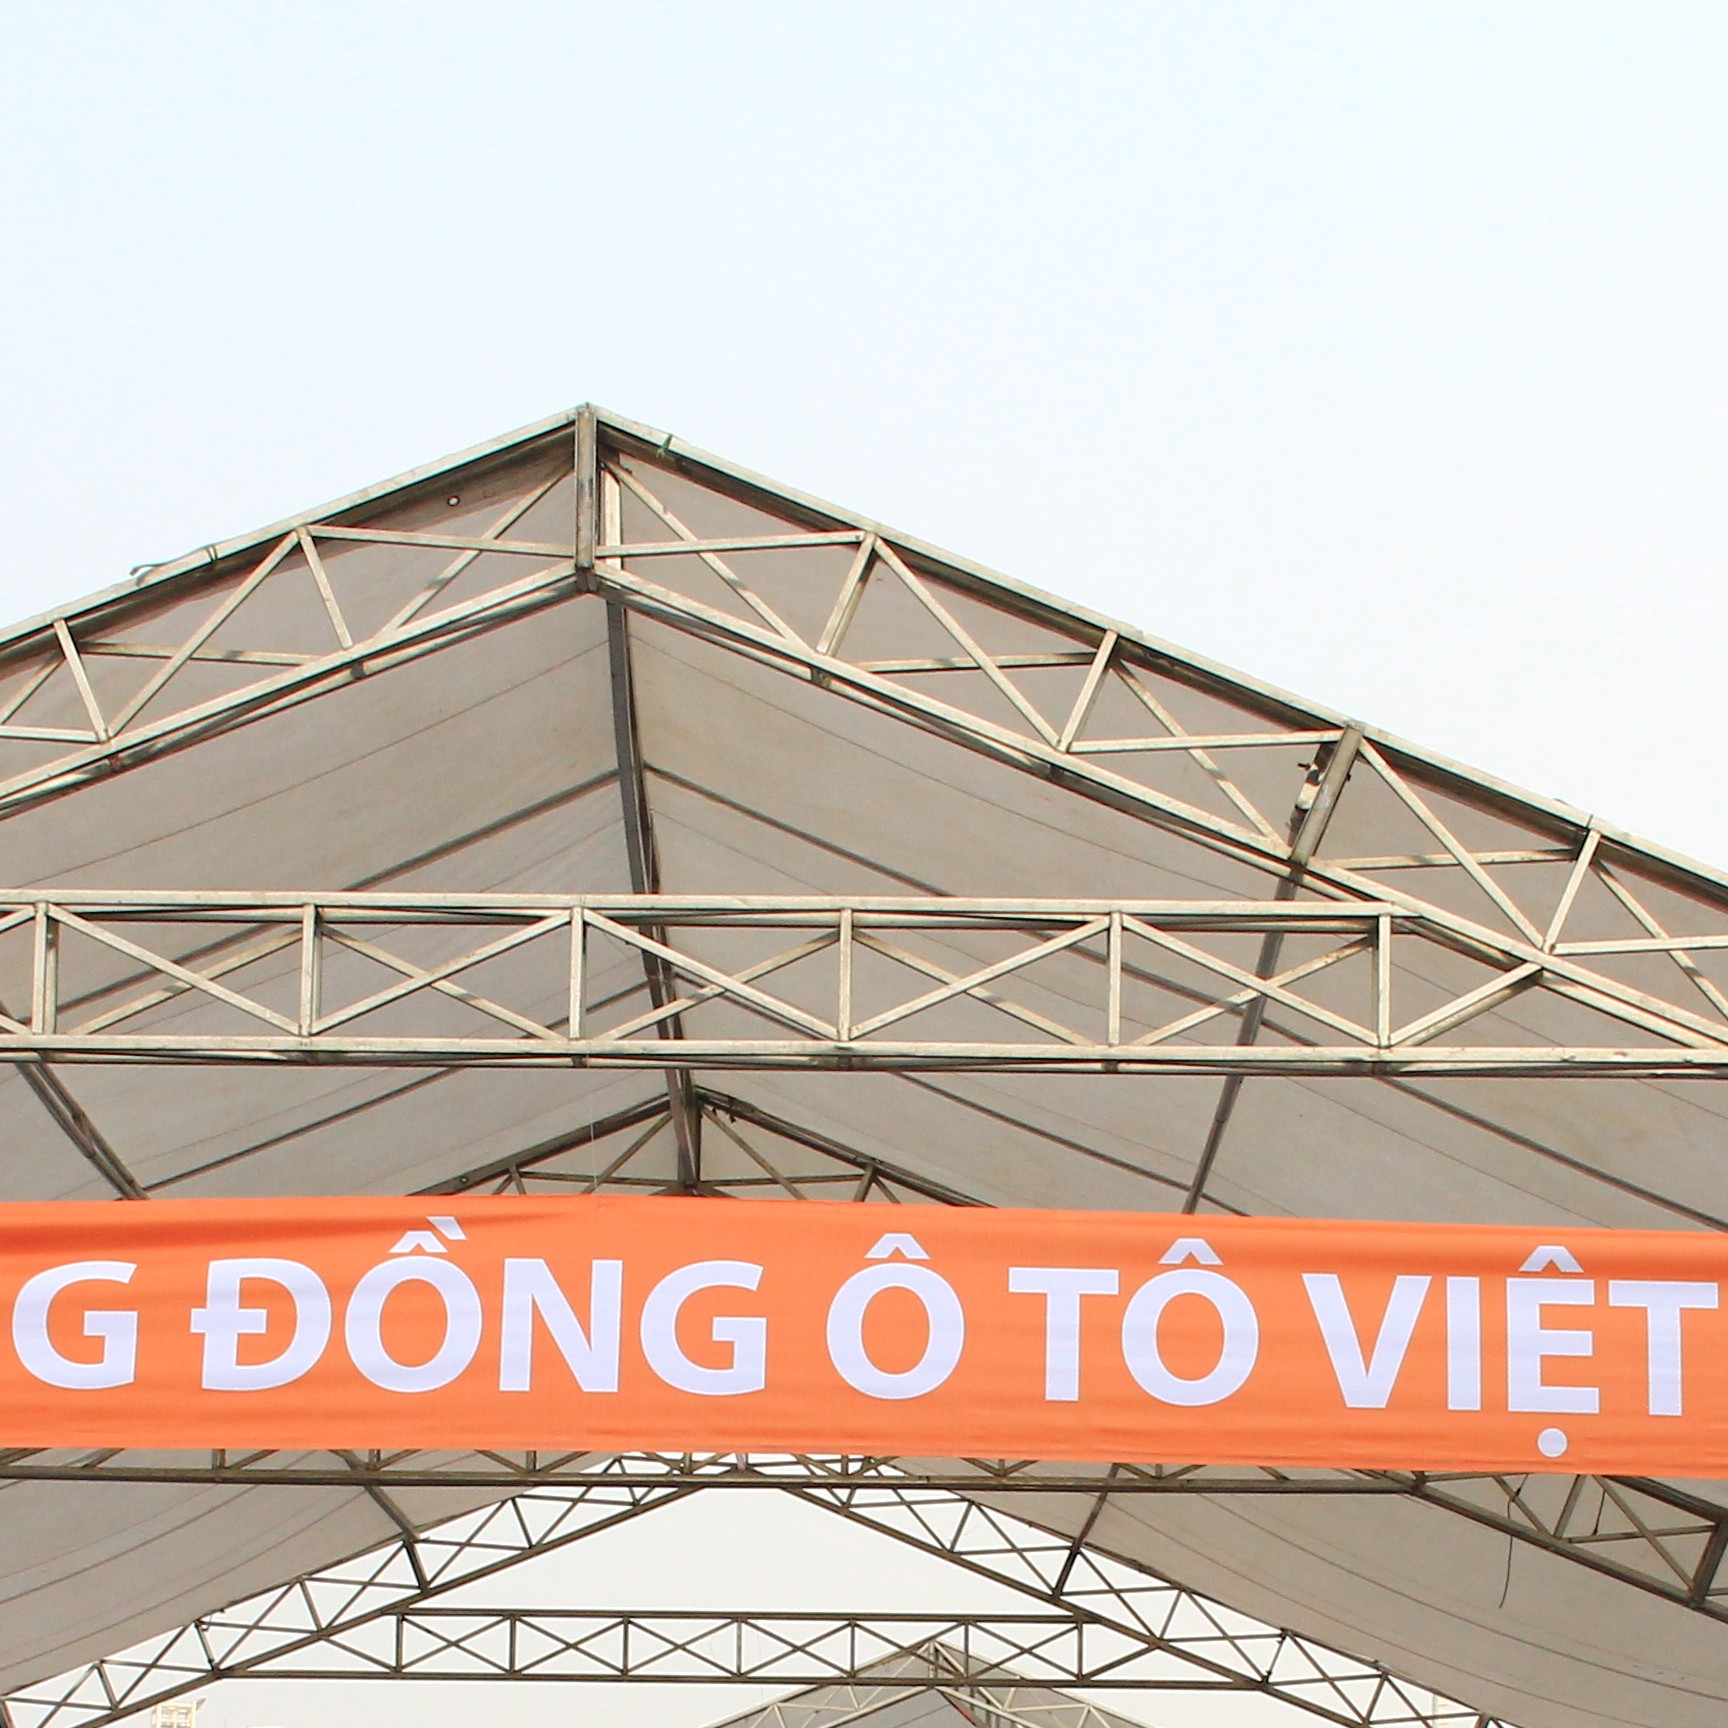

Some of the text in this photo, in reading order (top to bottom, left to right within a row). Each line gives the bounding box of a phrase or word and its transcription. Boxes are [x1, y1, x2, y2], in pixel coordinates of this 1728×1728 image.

[190, 1216, 769, 1394] ĐỒNG
[825, 1232, 965, 1400] Ô
[1007, 1237, 1260, 1406] TÔ
[1302, 1245, 1720, 1458] VIỆT
